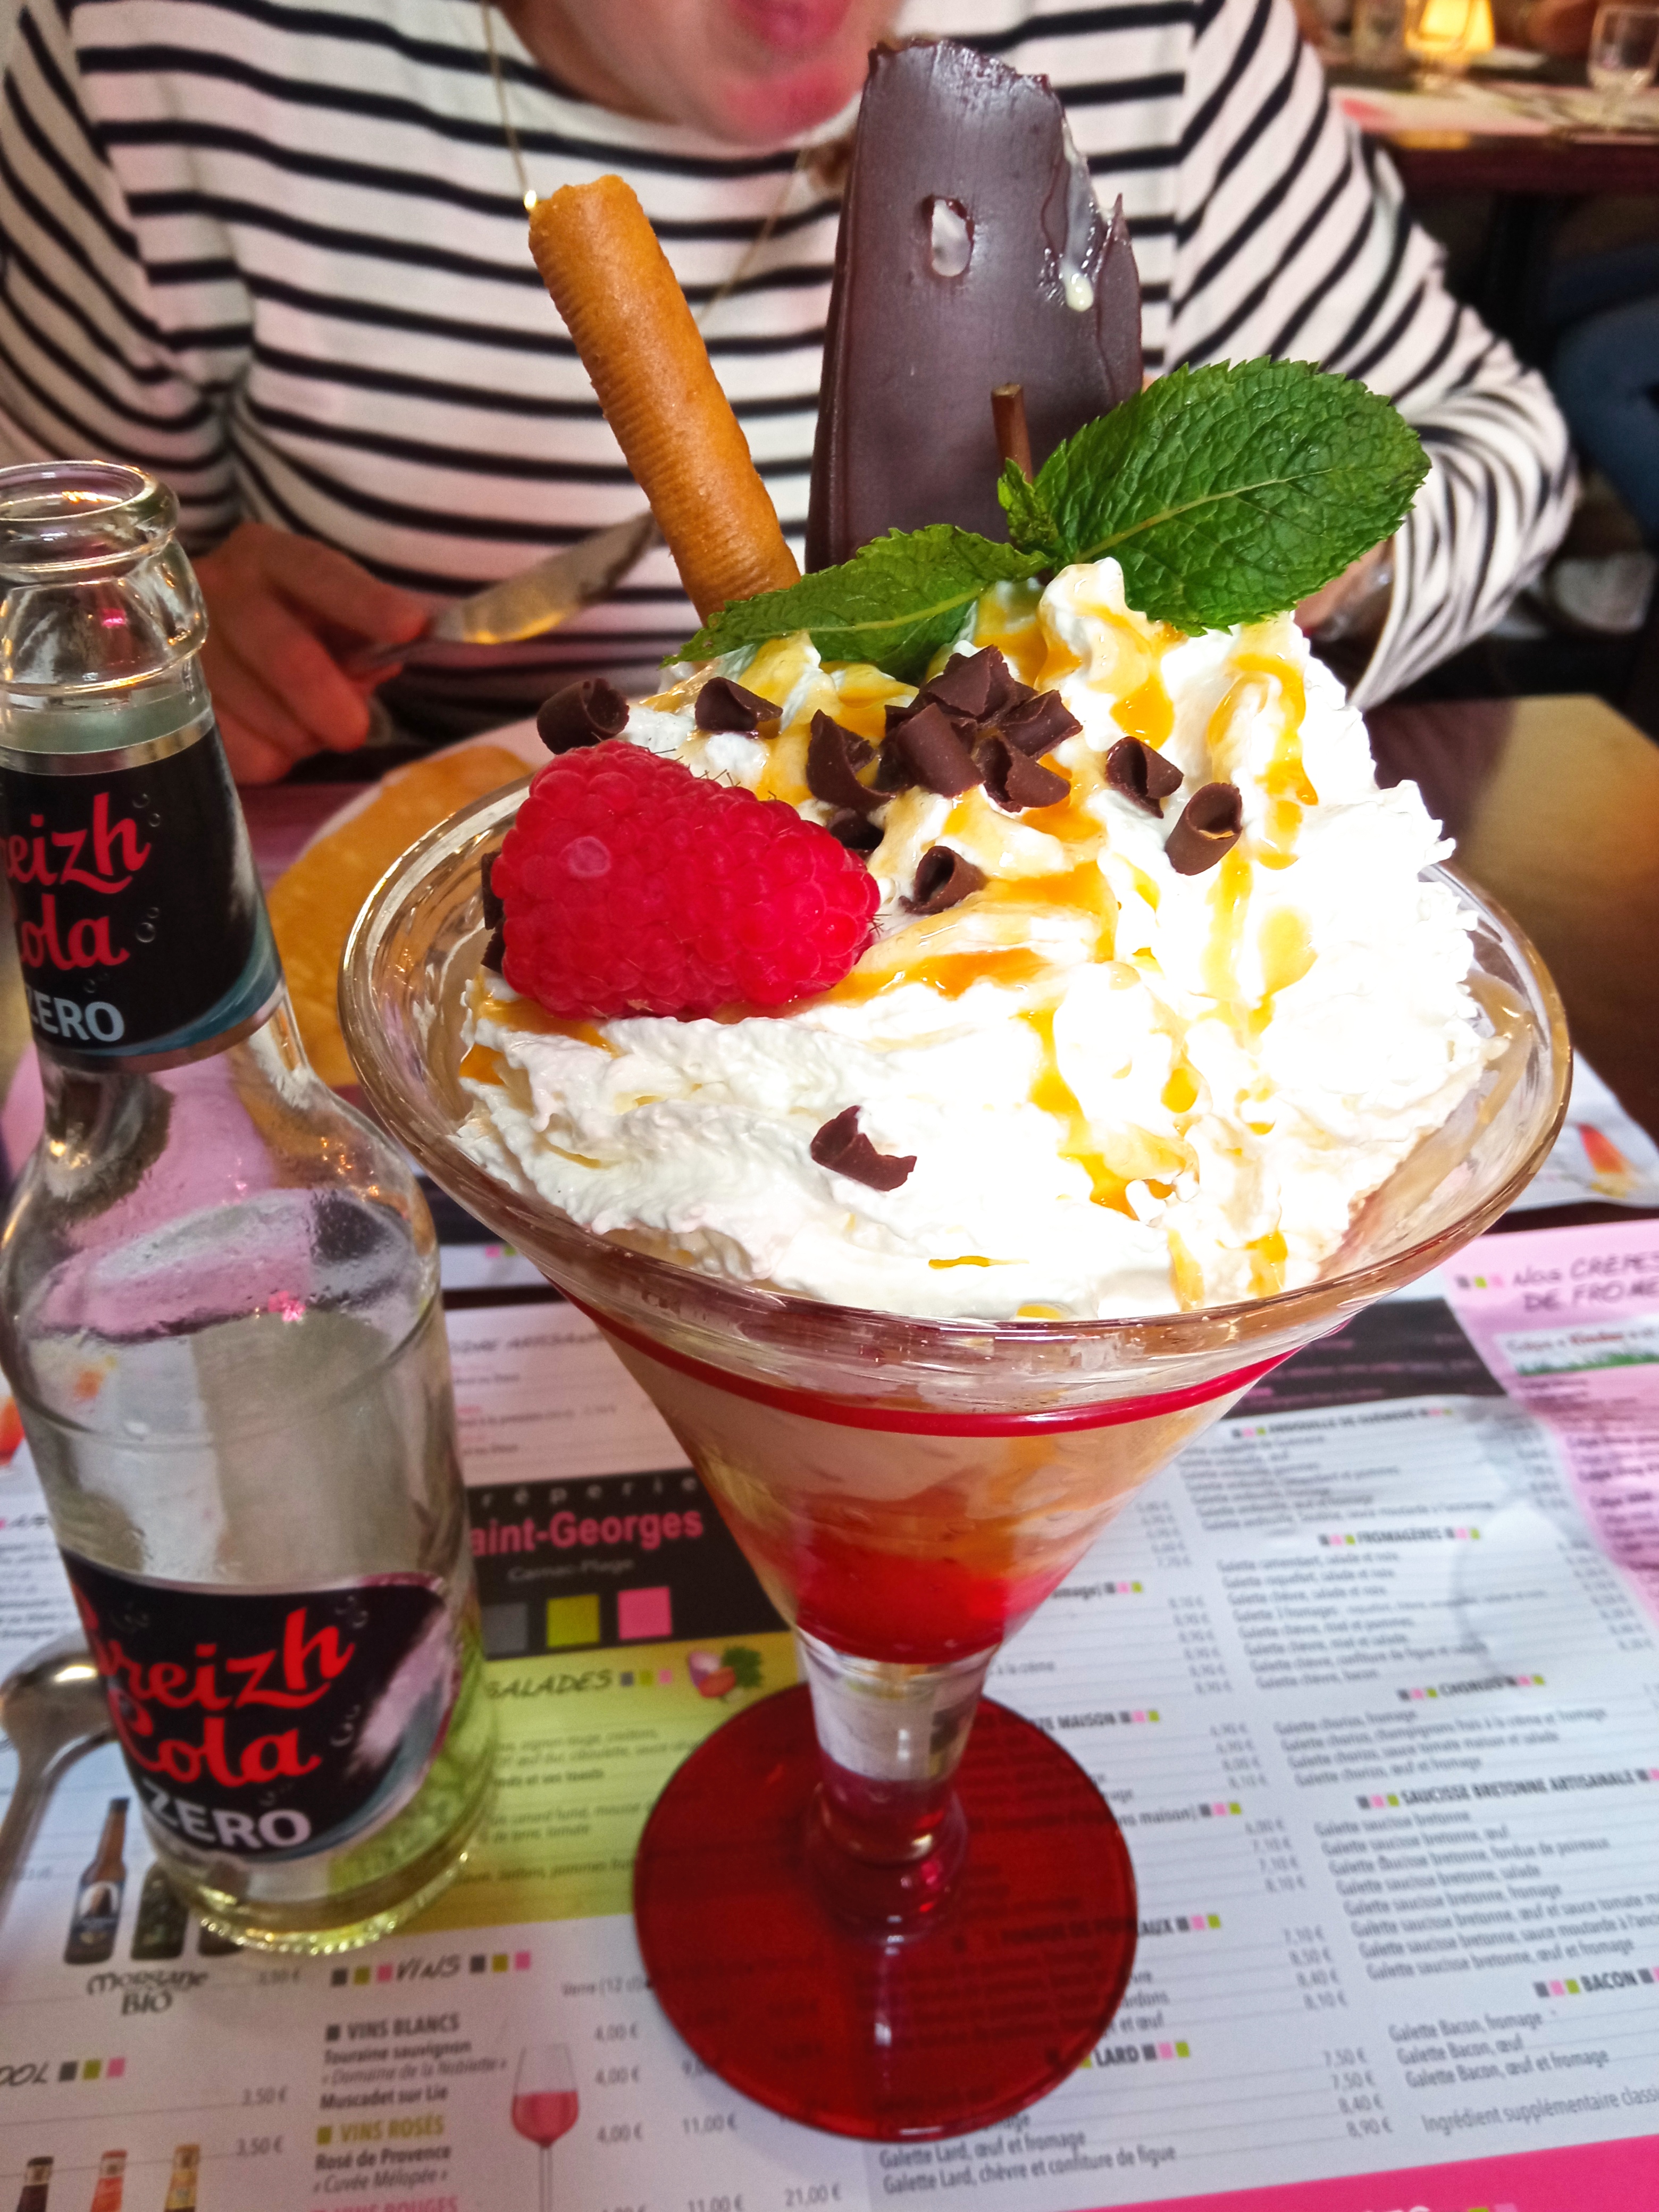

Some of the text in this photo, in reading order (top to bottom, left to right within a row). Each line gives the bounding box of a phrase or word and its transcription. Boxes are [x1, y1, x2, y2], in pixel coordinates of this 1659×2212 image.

[4, 792, 151, 894] eizh
[19, 893, 131, 971] ola
[1523, 1287, 1561, 1312] DE
[471, 1510, 703, 1557] aint-Georges
[484, 1668, 612, 1698] SALADES
[108, 1689, 322, 1788] Cola
[141, 1776, 312, 1849] ZERO
[1581, 1970, 1638, 1992] BACON
[0, 2062, 50, 2087] OOL
[1095, 2045, 1139, 2067] LARD
